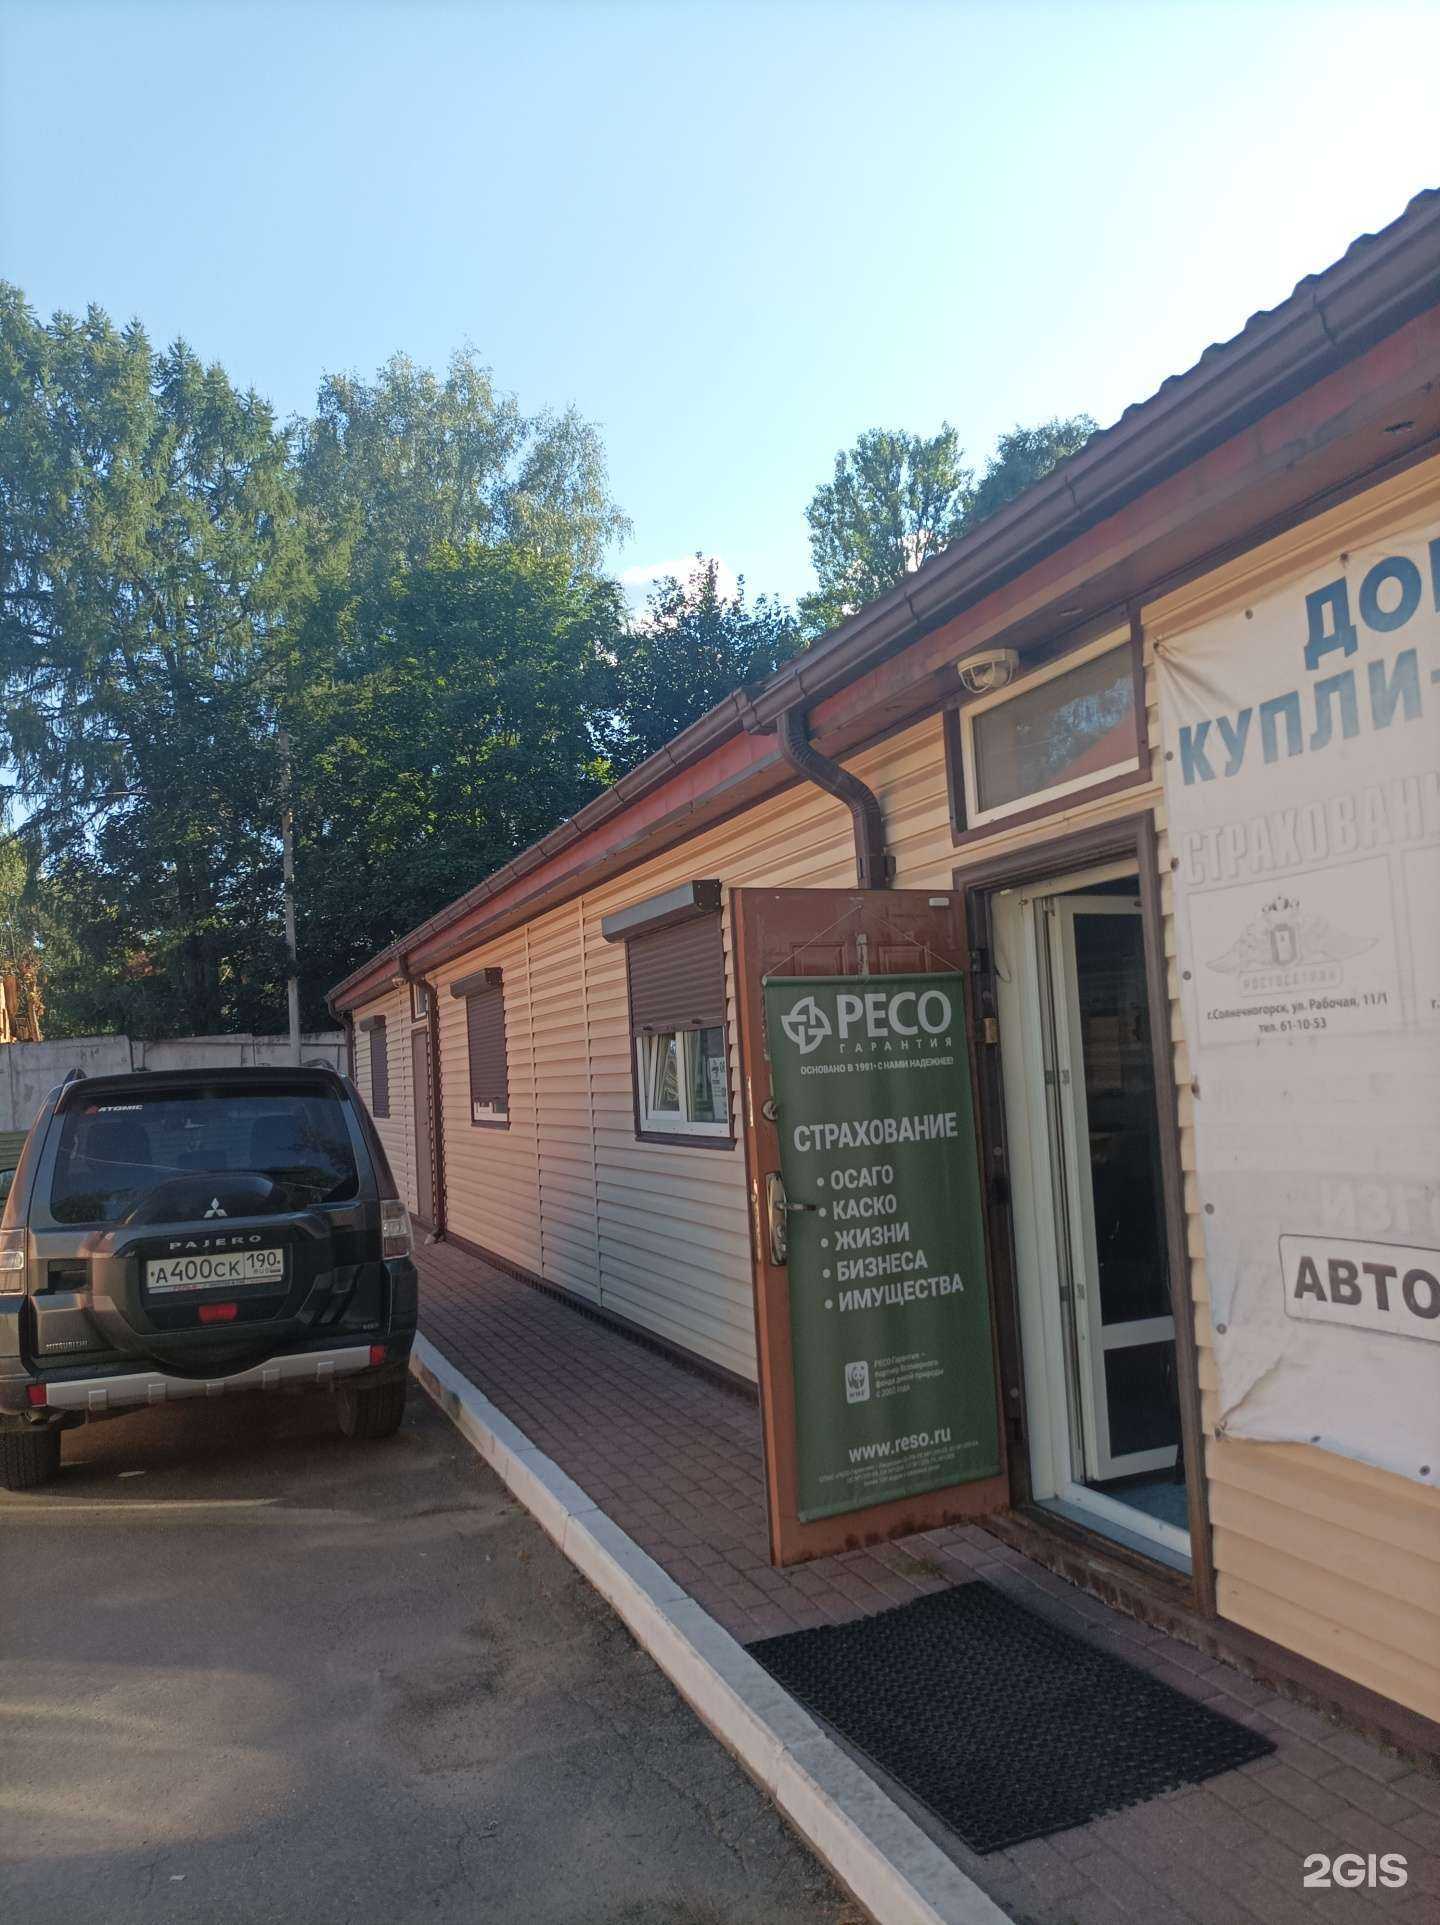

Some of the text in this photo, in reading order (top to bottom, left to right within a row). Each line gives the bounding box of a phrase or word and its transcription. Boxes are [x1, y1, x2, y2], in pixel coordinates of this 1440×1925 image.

[836, 990, 952, 1039] РЕСО
[1280, 1017, 1327, 1032] 61-10-53
[840, 1037, 952, 1053] ГАРАНТИЯ
[793, 1112, 959, 1152] СТРАХОВАНИЕ
[830, 1164, 894, 1190] ОСАГО
[832, 1194, 897, 1221] КАСКО
[169, 1235, 262, 1250] PAJERO
[835, 1222, 910, 1251] ЖИЗНИ
[836, 1250, 928, 1282] БИЗНЕСА
[838, 1273, 964, 1312] ИМУЩЕСТВА
[849, 1427, 951, 1463] www.reso.ru
